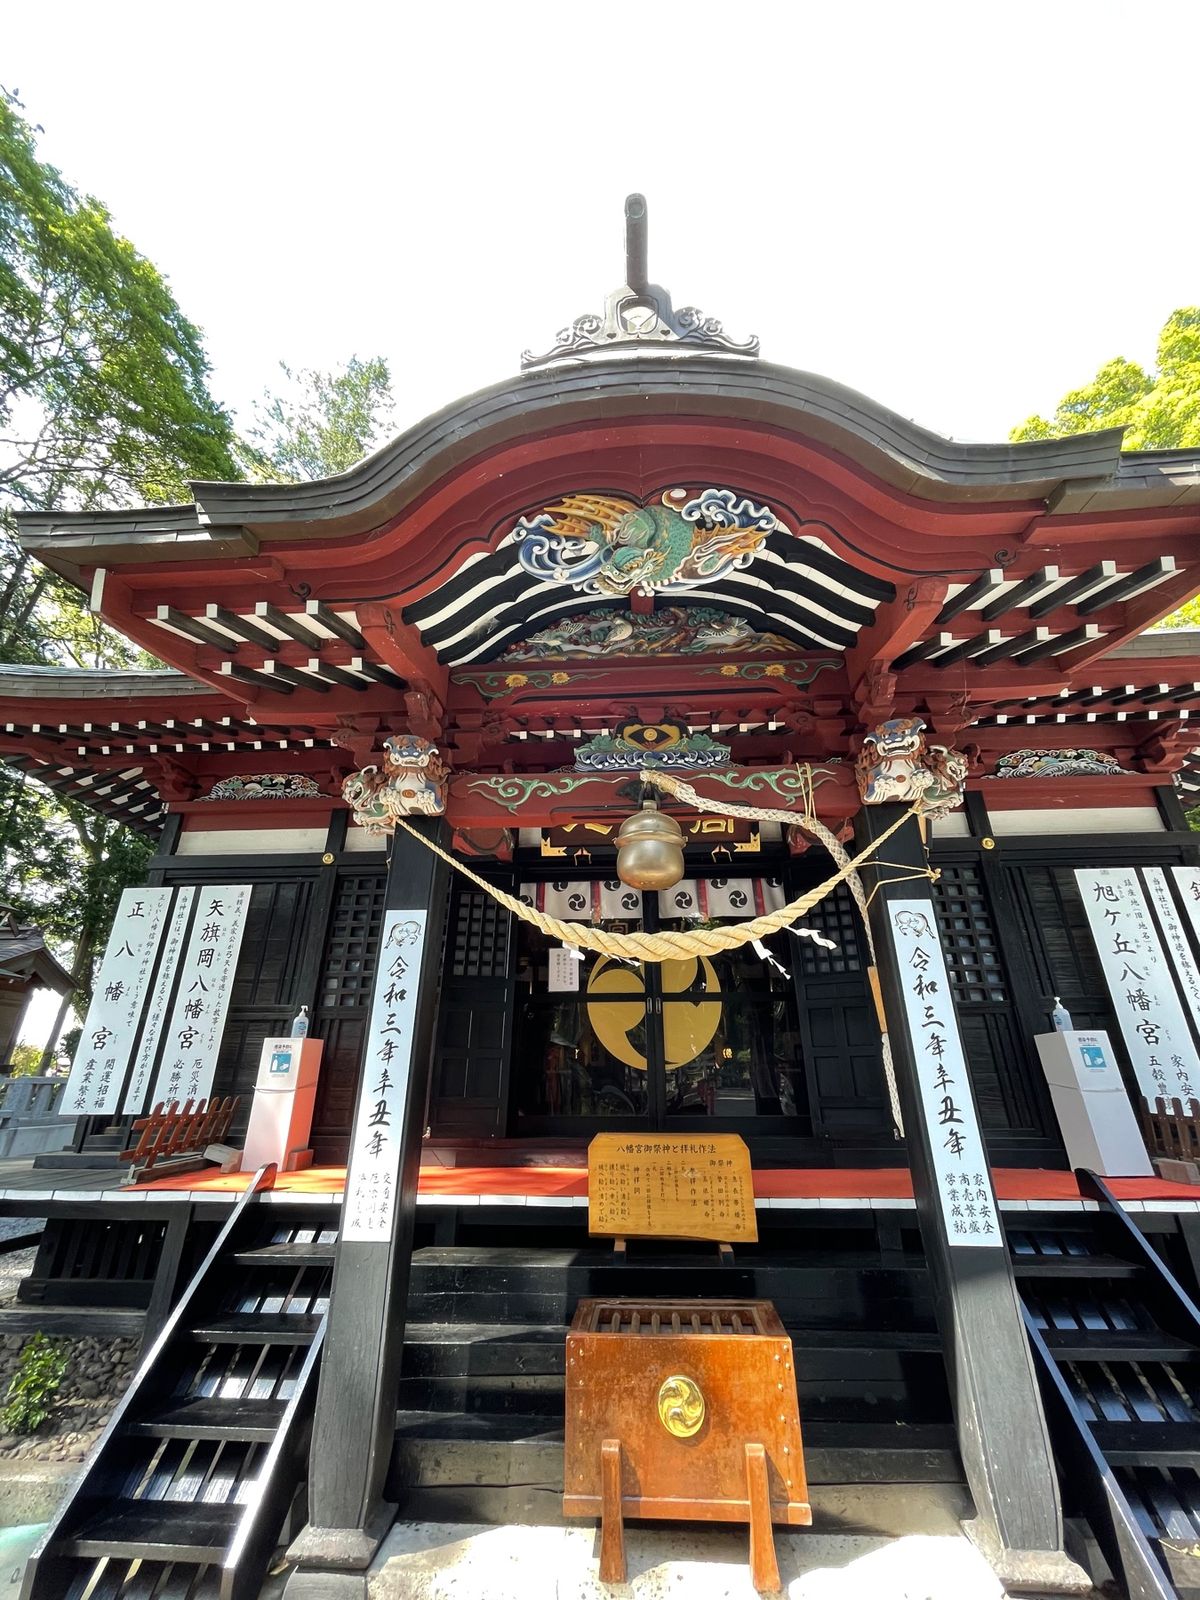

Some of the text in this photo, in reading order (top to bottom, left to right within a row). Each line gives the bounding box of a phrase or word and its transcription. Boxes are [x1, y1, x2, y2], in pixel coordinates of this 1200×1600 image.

[91, 899, 146, 1052] 正八幡宮
[176, 897, 225, 1053] 矢旗岡八幡宮
[93, 1058, 116, 1109] 開運招福
[363, 955, 411, 1160] 令和三年辛丑年
[909, 945, 967, 1161] 令和三年辛丑年
[73, 1058, 98, 1110] 産業繁栄
[945, 1173, 967, 1234] 学業成就
[959, 1173, 981, 1234] 商売繁盛
[972, 1173, 995, 1234] 家内安全
